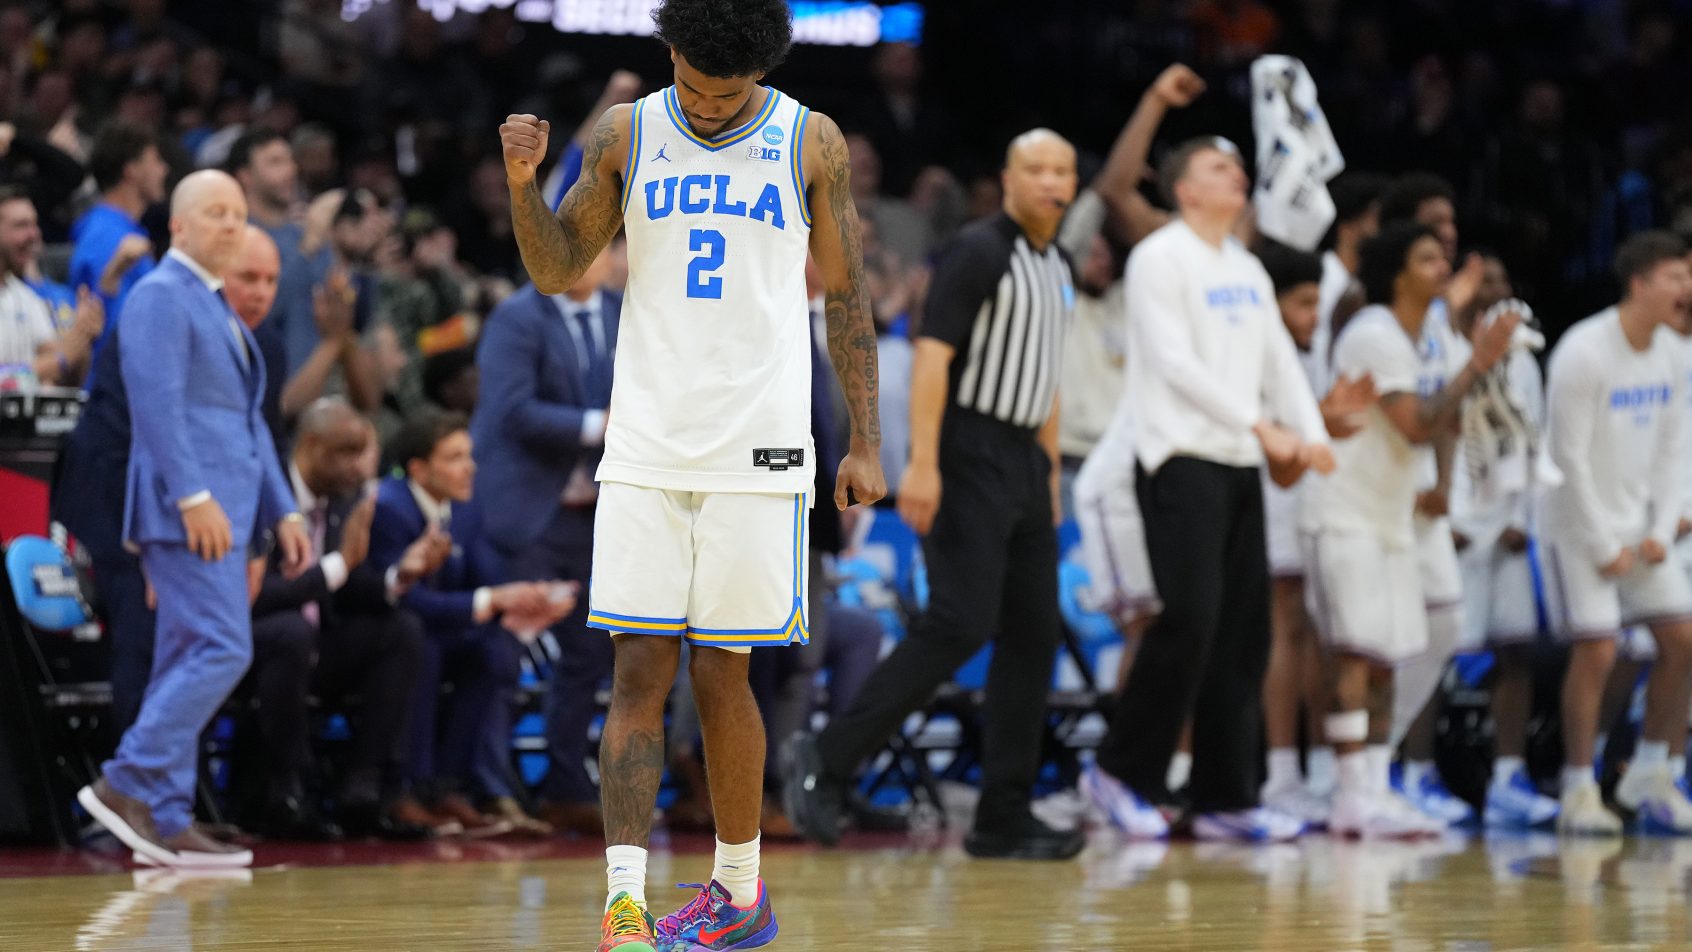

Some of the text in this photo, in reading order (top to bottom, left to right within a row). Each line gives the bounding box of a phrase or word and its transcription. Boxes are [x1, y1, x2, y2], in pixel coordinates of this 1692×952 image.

[645, 174, 786, 231] UCLA
[686, 228, 726, 299] 2
[864, 354, 880, 434] FEAR GOD
